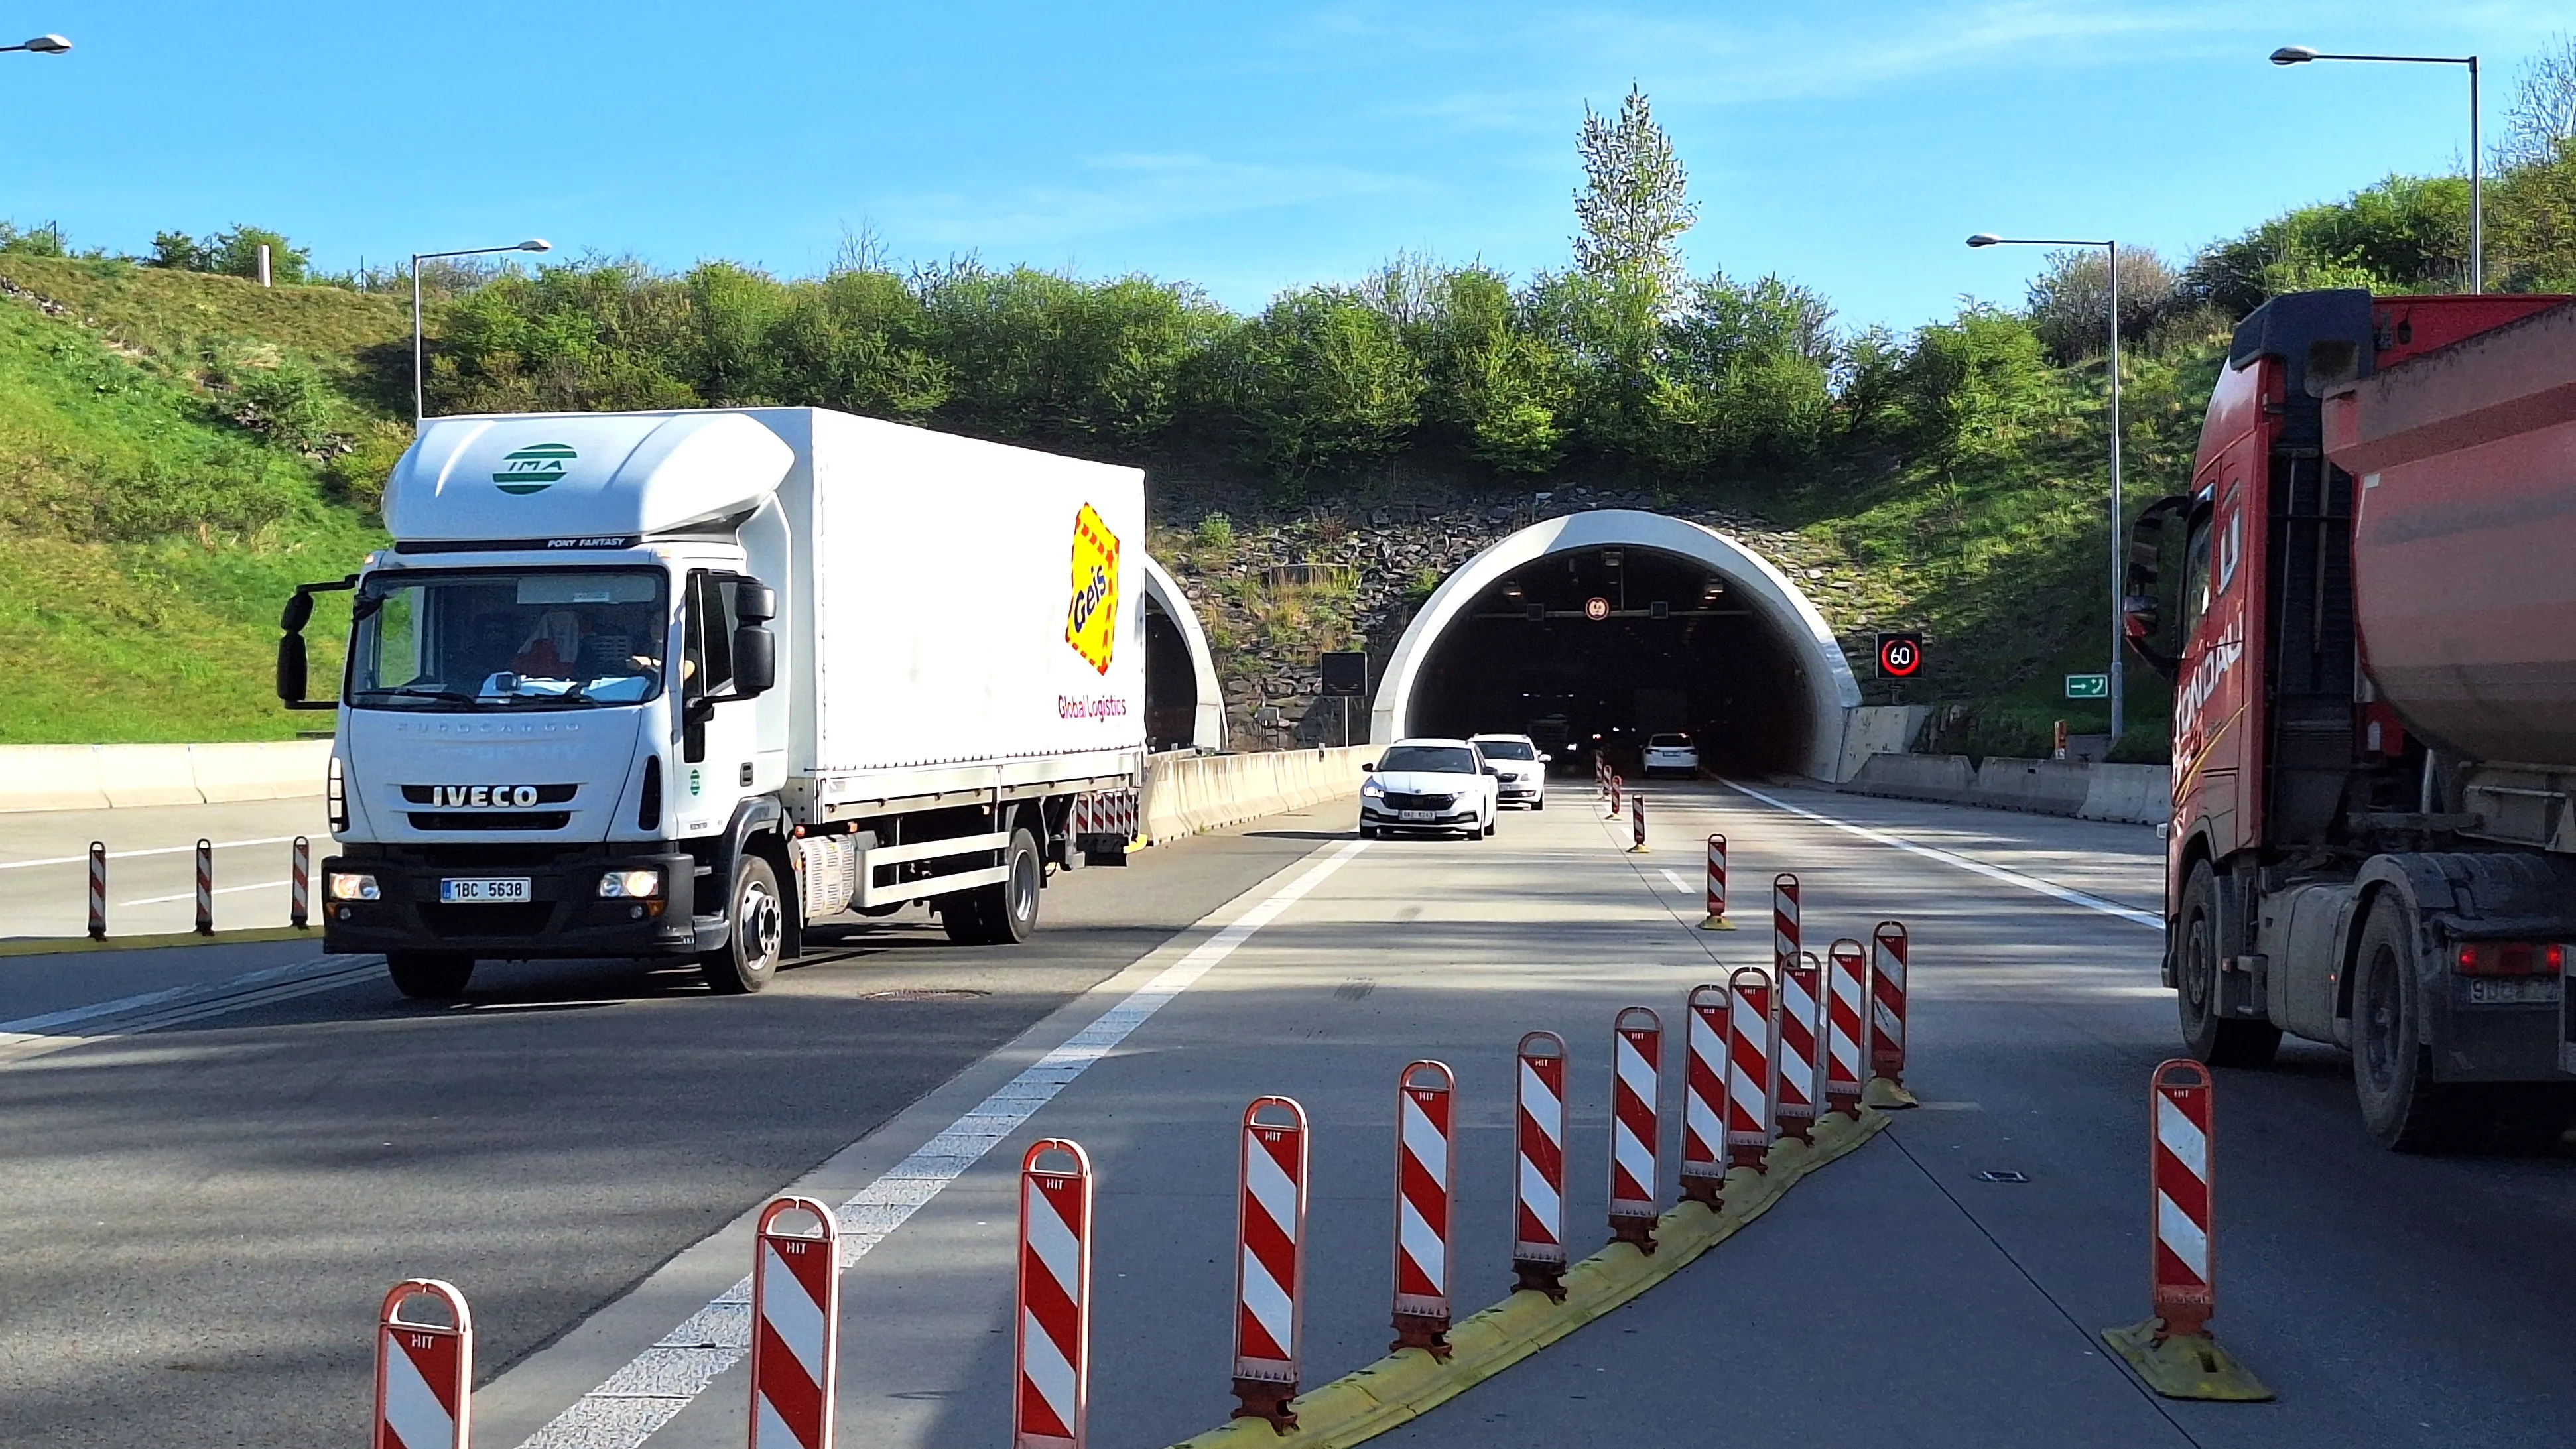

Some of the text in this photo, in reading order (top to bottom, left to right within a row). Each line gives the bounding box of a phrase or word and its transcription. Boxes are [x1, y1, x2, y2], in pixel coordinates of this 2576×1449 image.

[508, 460, 562, 472] IMA
[547, 538, 625, 548] PONY FANTASY
[1074, 564, 1106, 633] Geis
[1890, 647, 1910, 664] 60
[1058, 694, 1126, 723] Global Logistics
[433, 786, 538, 808] IVECO
[455, 882, 523, 897] 1BC 5638
[1419, 1092, 1434, 1102] HIT
[1265, 1130, 1283, 1142] HIT
[1046, 1178, 1065, 1190] HIT
[786, 1241, 807, 1255] HIT
[411, 1334, 434, 1350] HIT
